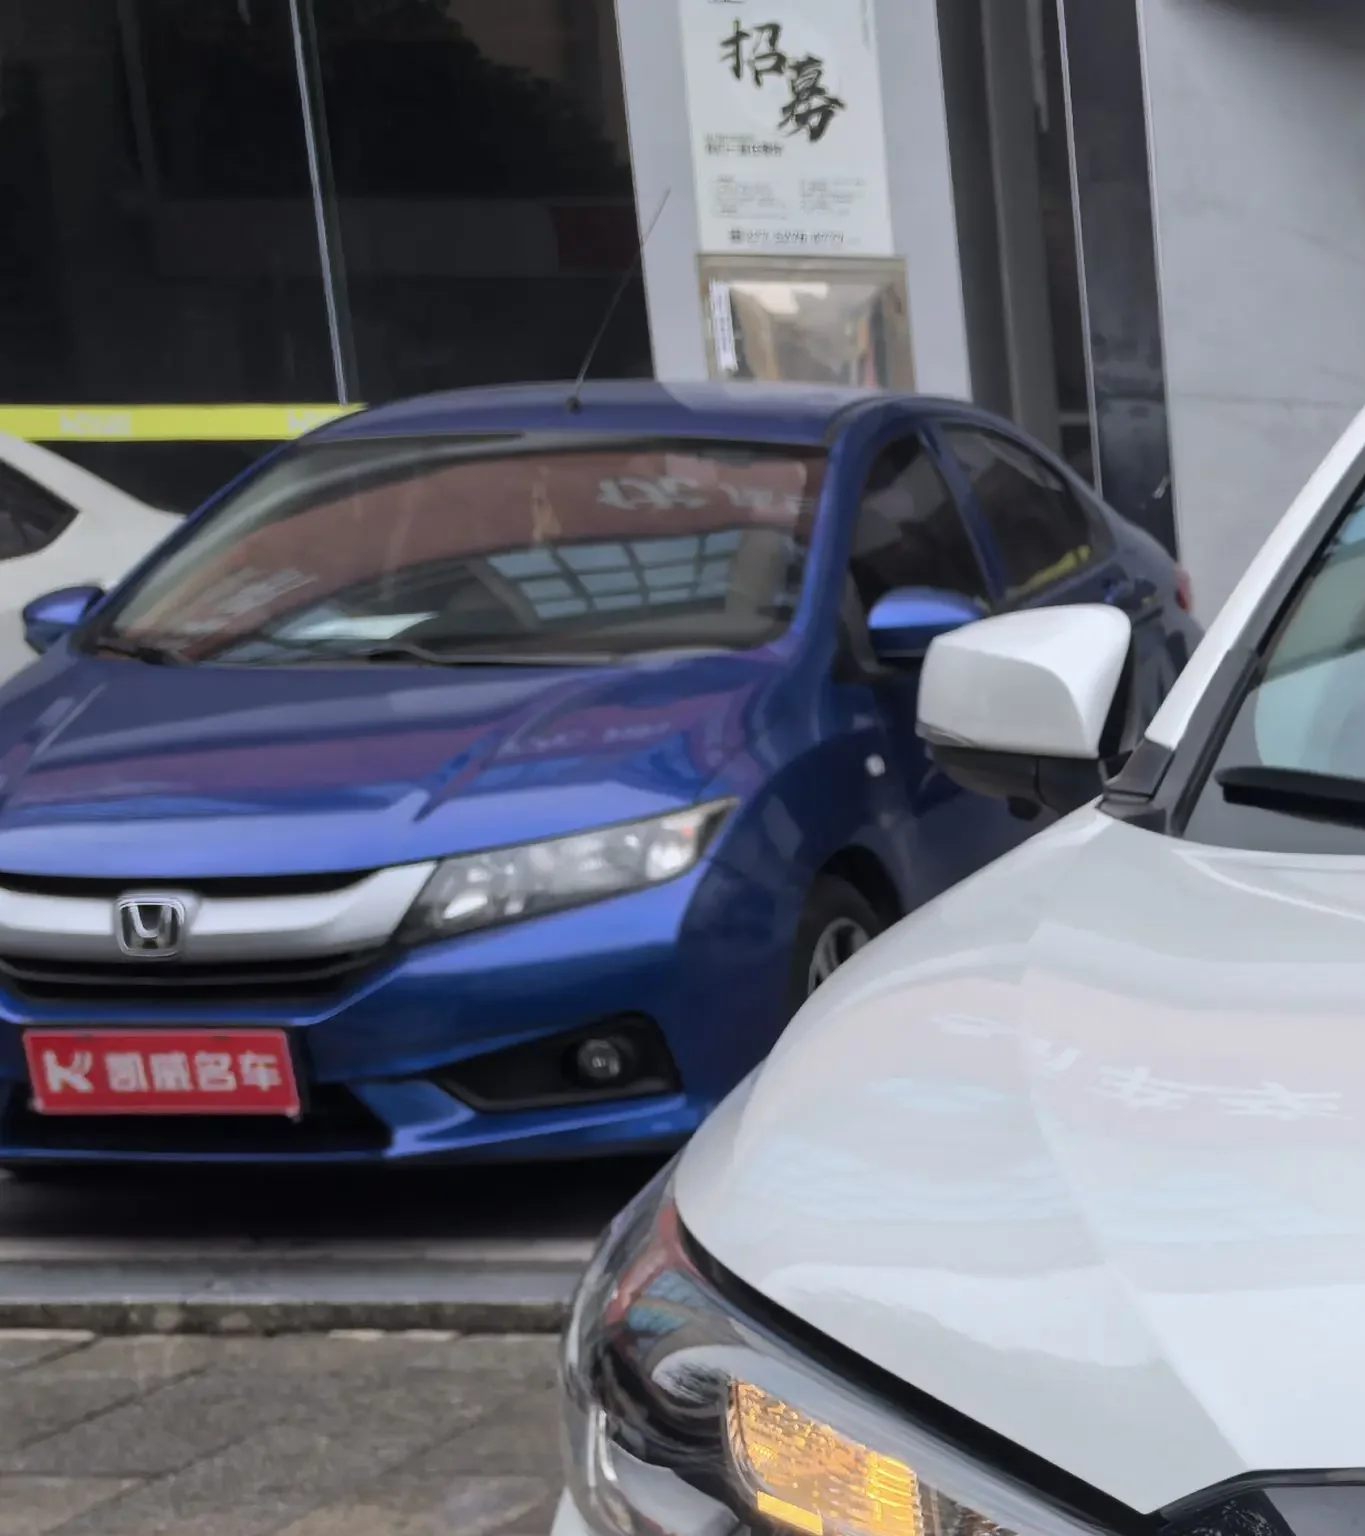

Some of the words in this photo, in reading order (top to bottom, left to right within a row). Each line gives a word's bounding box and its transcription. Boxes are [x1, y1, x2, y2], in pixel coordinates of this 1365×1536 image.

[720, 17, 845, 142] 招募
[105, 1048, 282, 1092] 凯威名车
